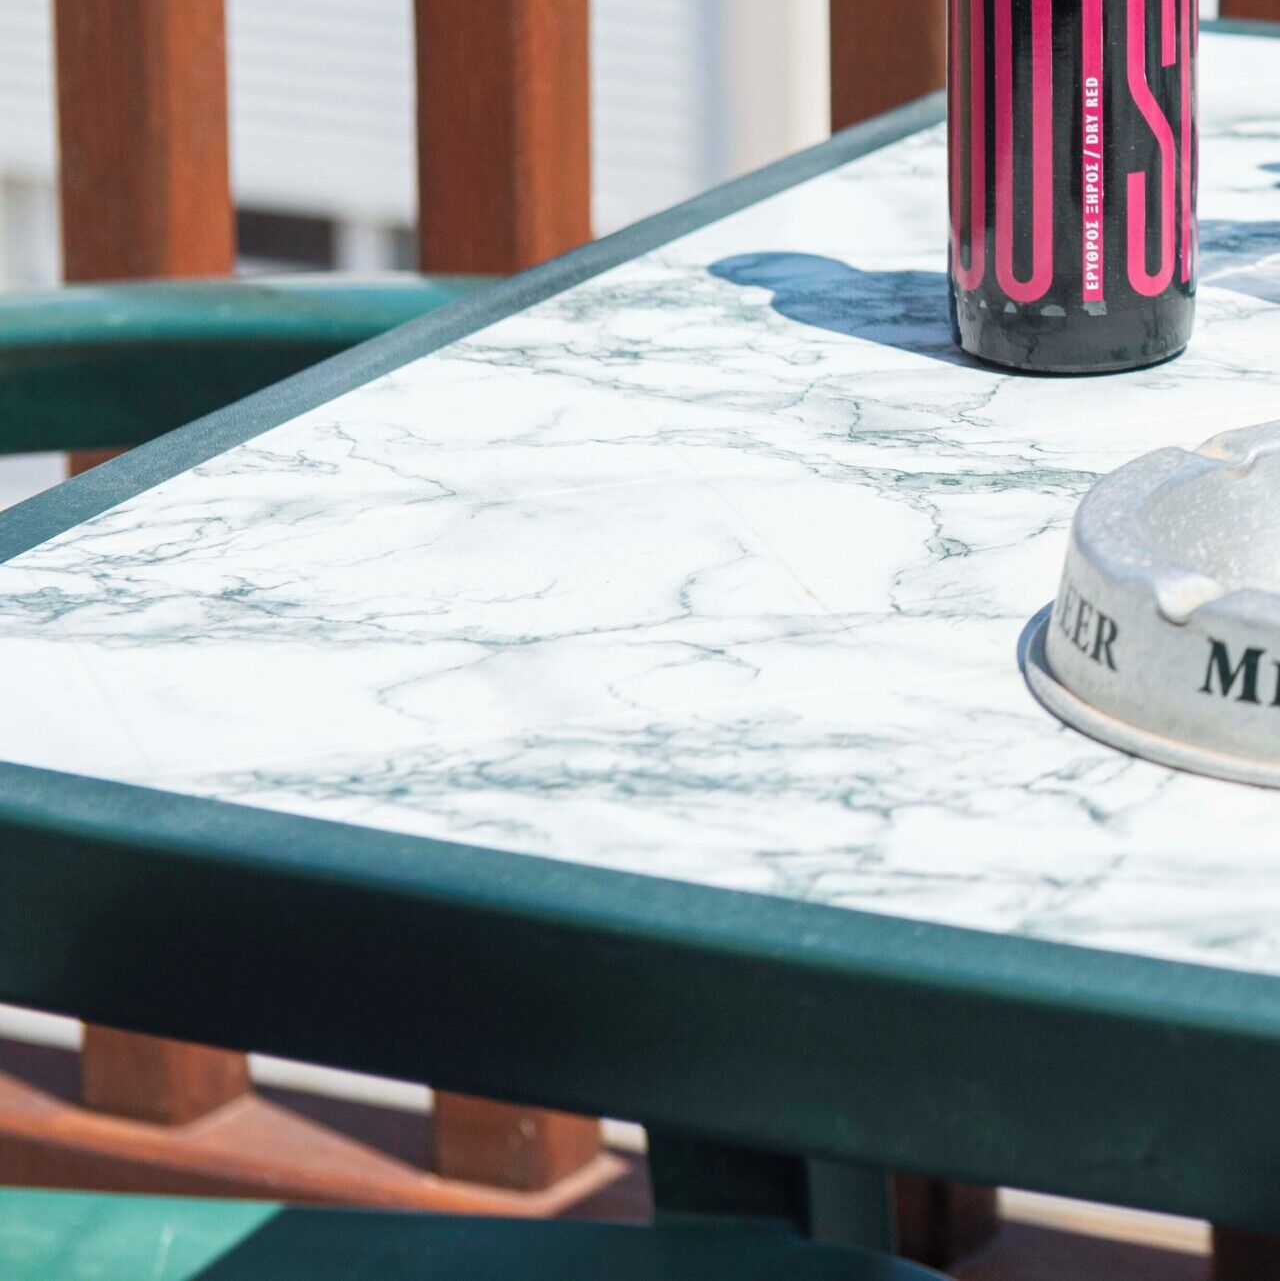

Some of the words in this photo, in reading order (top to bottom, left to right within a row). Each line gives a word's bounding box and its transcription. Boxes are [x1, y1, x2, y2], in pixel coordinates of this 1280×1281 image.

[1085, 77, 1100, 108] RED
[1085, 109, 1101, 146] DRY
[1085, 163, 1101, 215] ΞΗΡΟΣ
[1085, 221, 1101, 290] ΕΡΥΘΡΟΣ
[1059, 584, 1119, 671] EER
